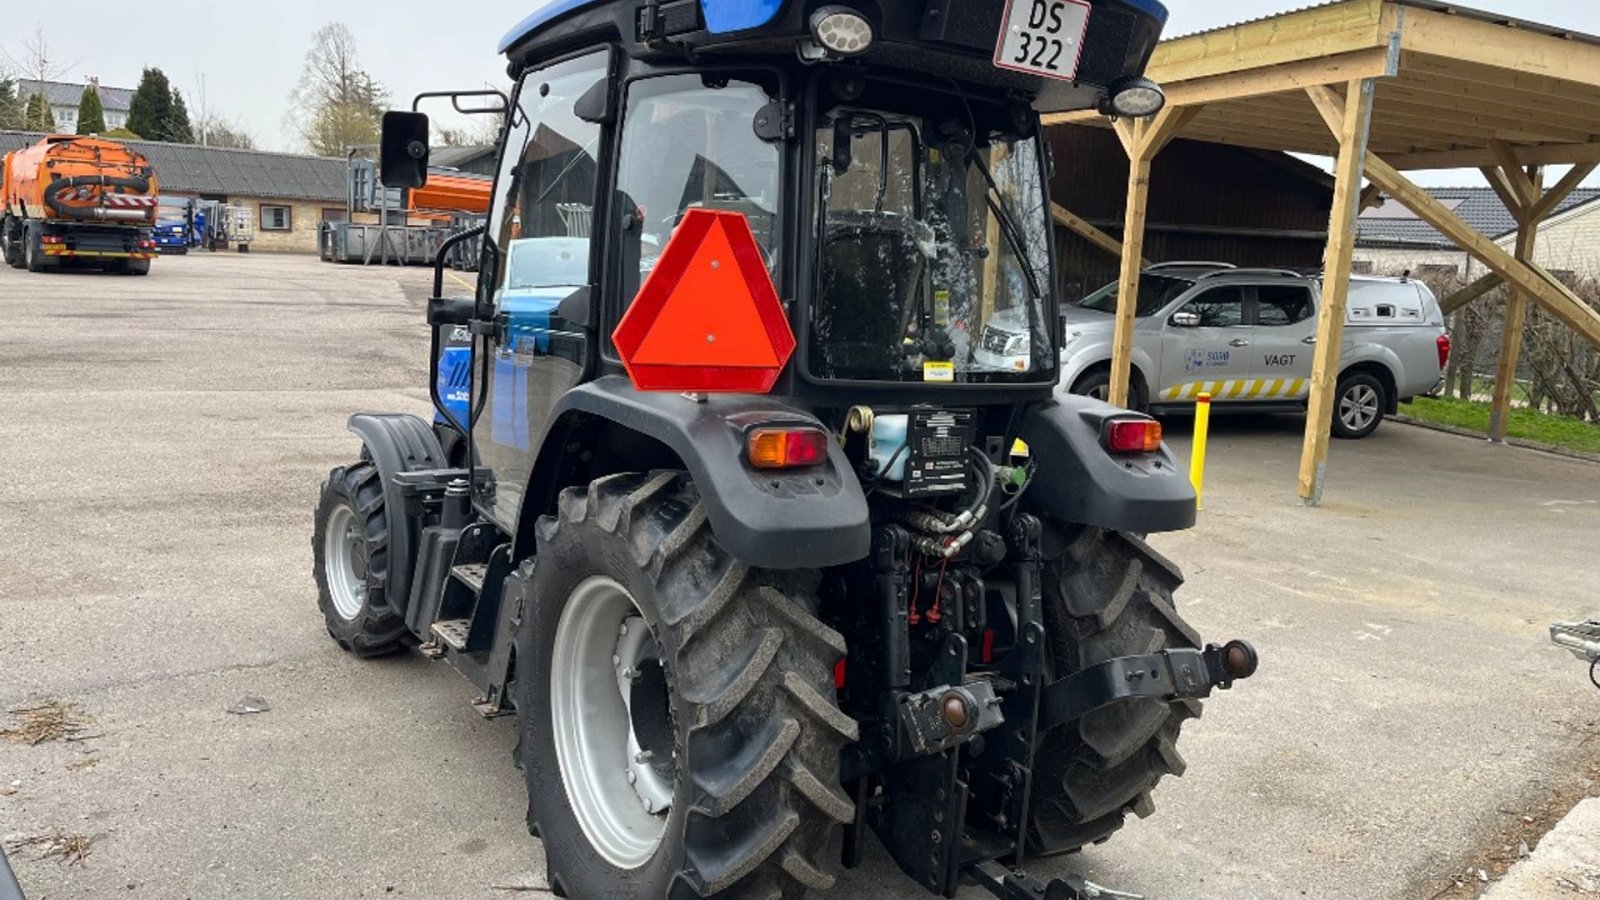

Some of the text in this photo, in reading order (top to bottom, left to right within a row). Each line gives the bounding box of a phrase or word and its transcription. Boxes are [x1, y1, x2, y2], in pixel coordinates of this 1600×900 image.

[1028, 0, 1065, 33] DS
[1014, 31, 1063, 70] 322
[1264, 354, 1297, 366] VAGT
